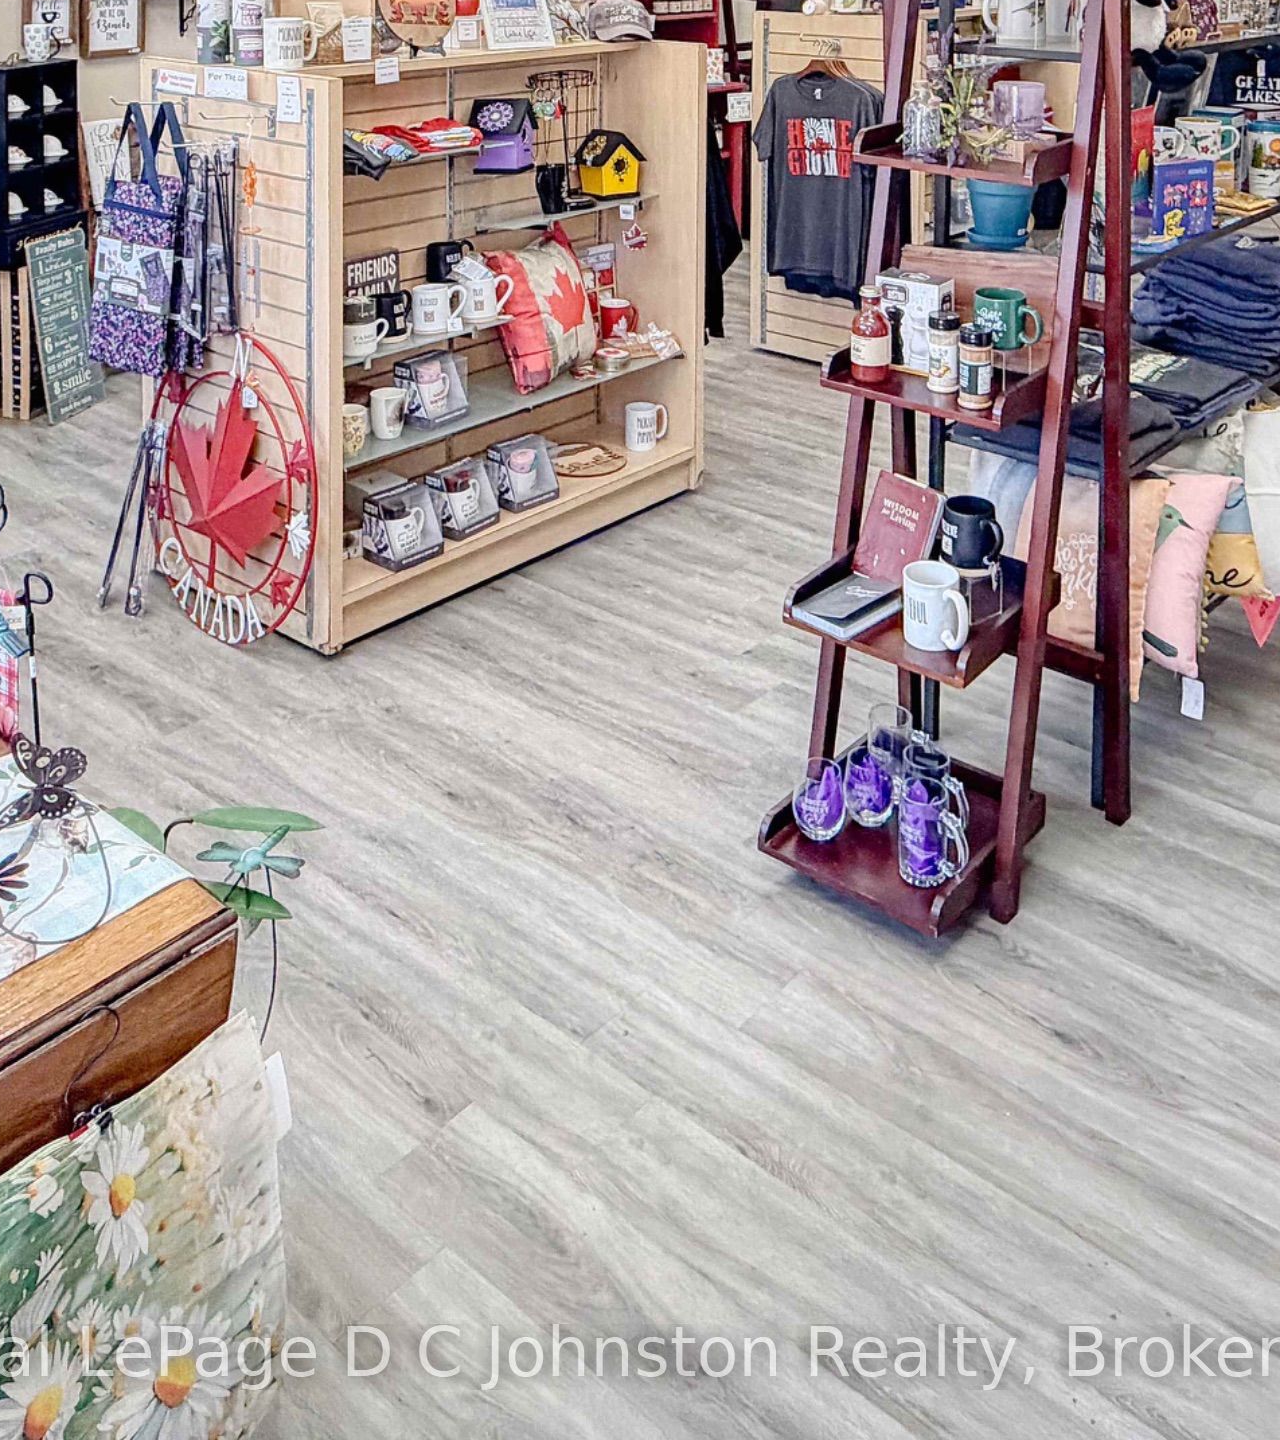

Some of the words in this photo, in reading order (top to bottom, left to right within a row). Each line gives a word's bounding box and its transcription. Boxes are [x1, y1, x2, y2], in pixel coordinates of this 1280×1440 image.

[347, 253, 397, 288] FRIENDS
[70, 305, 79, 321] 5
[44, 336, 53, 355] 6
[62, 367, 92, 392] smile
[882, 497, 920, 521] WISDOM
[890, 511, 918, 533] Living
[159, 536, 267, 645] CANADA
